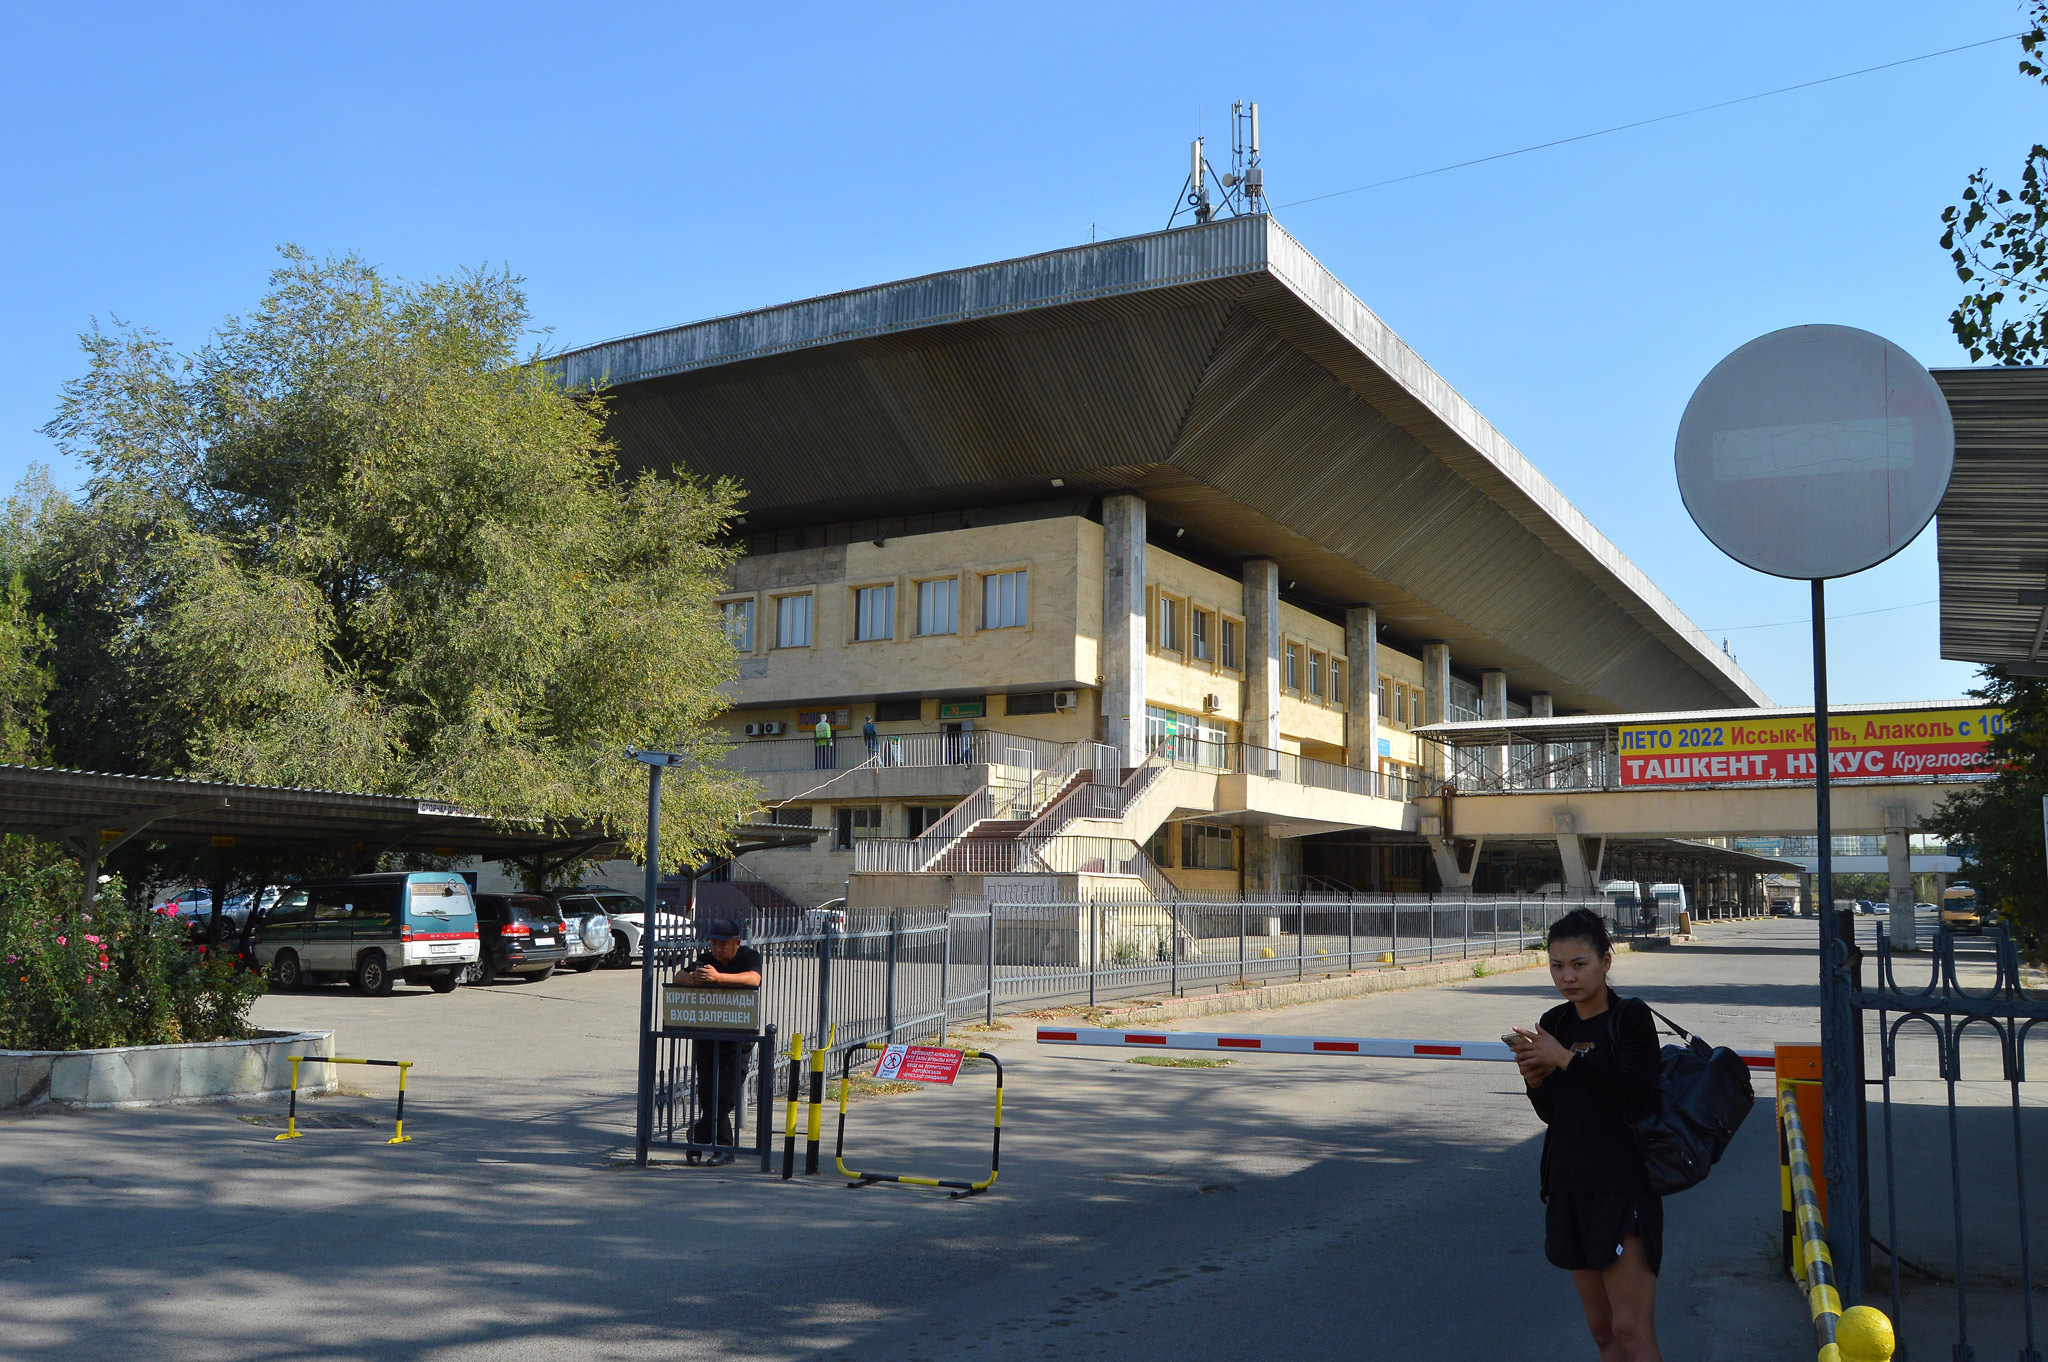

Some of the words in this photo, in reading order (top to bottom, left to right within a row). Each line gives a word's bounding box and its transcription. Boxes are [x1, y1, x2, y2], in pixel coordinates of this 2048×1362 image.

[799, 710, 836, 726] ЛОМБРД
[1621, 729, 1672, 750] ЛЕТО
[1678, 727, 1724, 748] 2022
[1731, 722, 1857, 746] Иссык-Кль,
[1863, 720, 1954, 740] Алаколь
[1958, 721, 1971, 736] с
[1627, 754, 1777, 780] ТАШКЕНТ,
[666, 991, 697, 1004] КІРУГЕ
[699, 991, 755, 1008] БОЛМАЙДЫ
[670, 1009, 697, 1024] ВХОД
[698, 1010, 750, 1024] ЗАПРЕЩЕН
